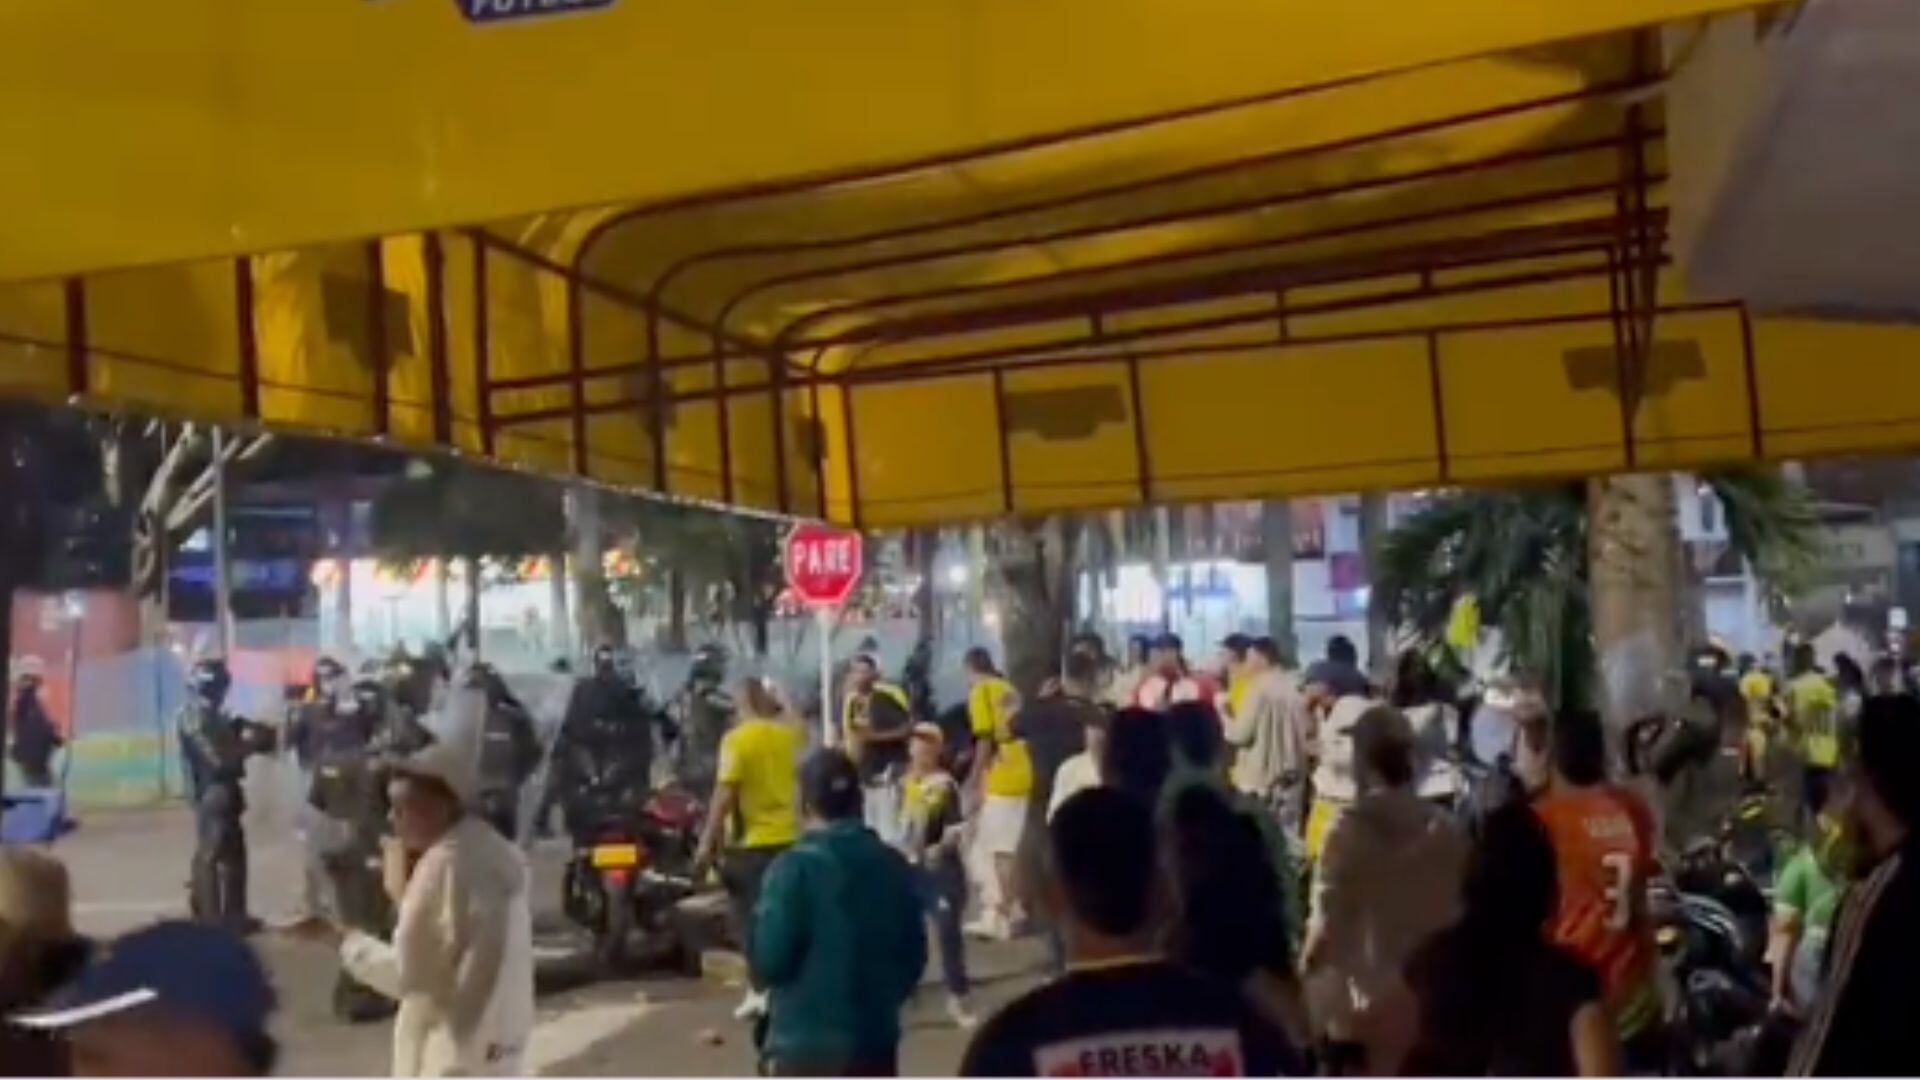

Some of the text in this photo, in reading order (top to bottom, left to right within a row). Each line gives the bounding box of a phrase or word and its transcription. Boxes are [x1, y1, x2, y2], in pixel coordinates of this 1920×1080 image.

[793, 540, 852, 574] PARE
[1601, 854, 1632, 930] 3
[1079, 1042, 1212, 1076] FRESKA
